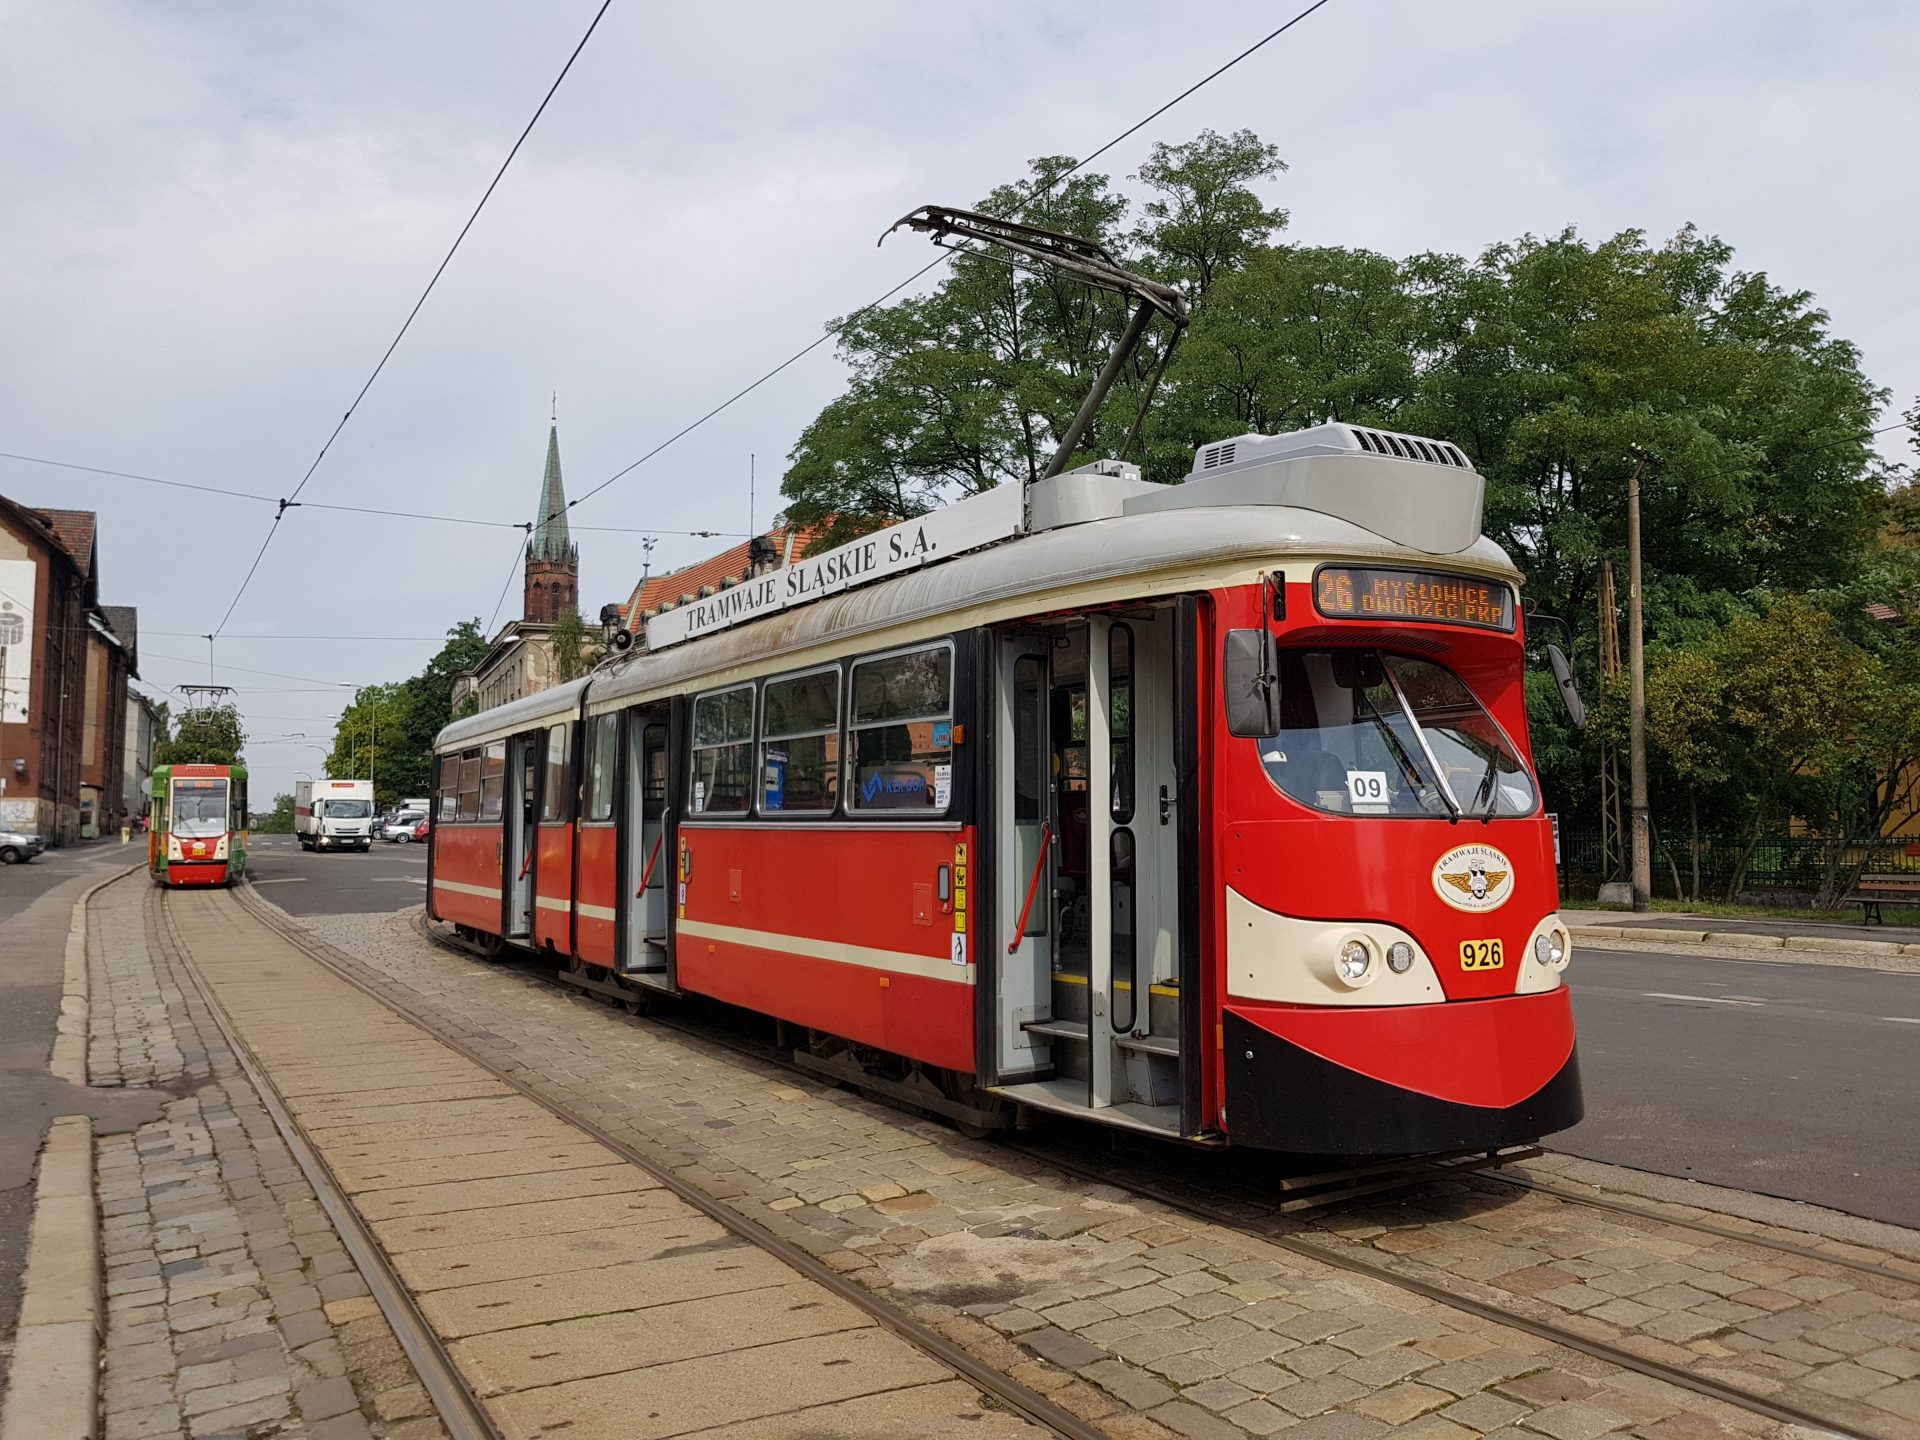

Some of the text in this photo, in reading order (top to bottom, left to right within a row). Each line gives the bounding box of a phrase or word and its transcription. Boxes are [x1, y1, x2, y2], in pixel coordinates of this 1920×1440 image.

[686, 525, 938, 632] TRAMWAJE ŚLĄSKIE S.A.
[1318, 573, 1353, 611] 26
[1373, 578, 1489, 606] MYSŁOWICE
[1362, 594, 1503, 623] DWORZEC PKP
[1354, 777, 1381, 798] 09
[1438, 847, 1480, 871] TRAMWAJE
[1463, 942, 1501, 968] 926
